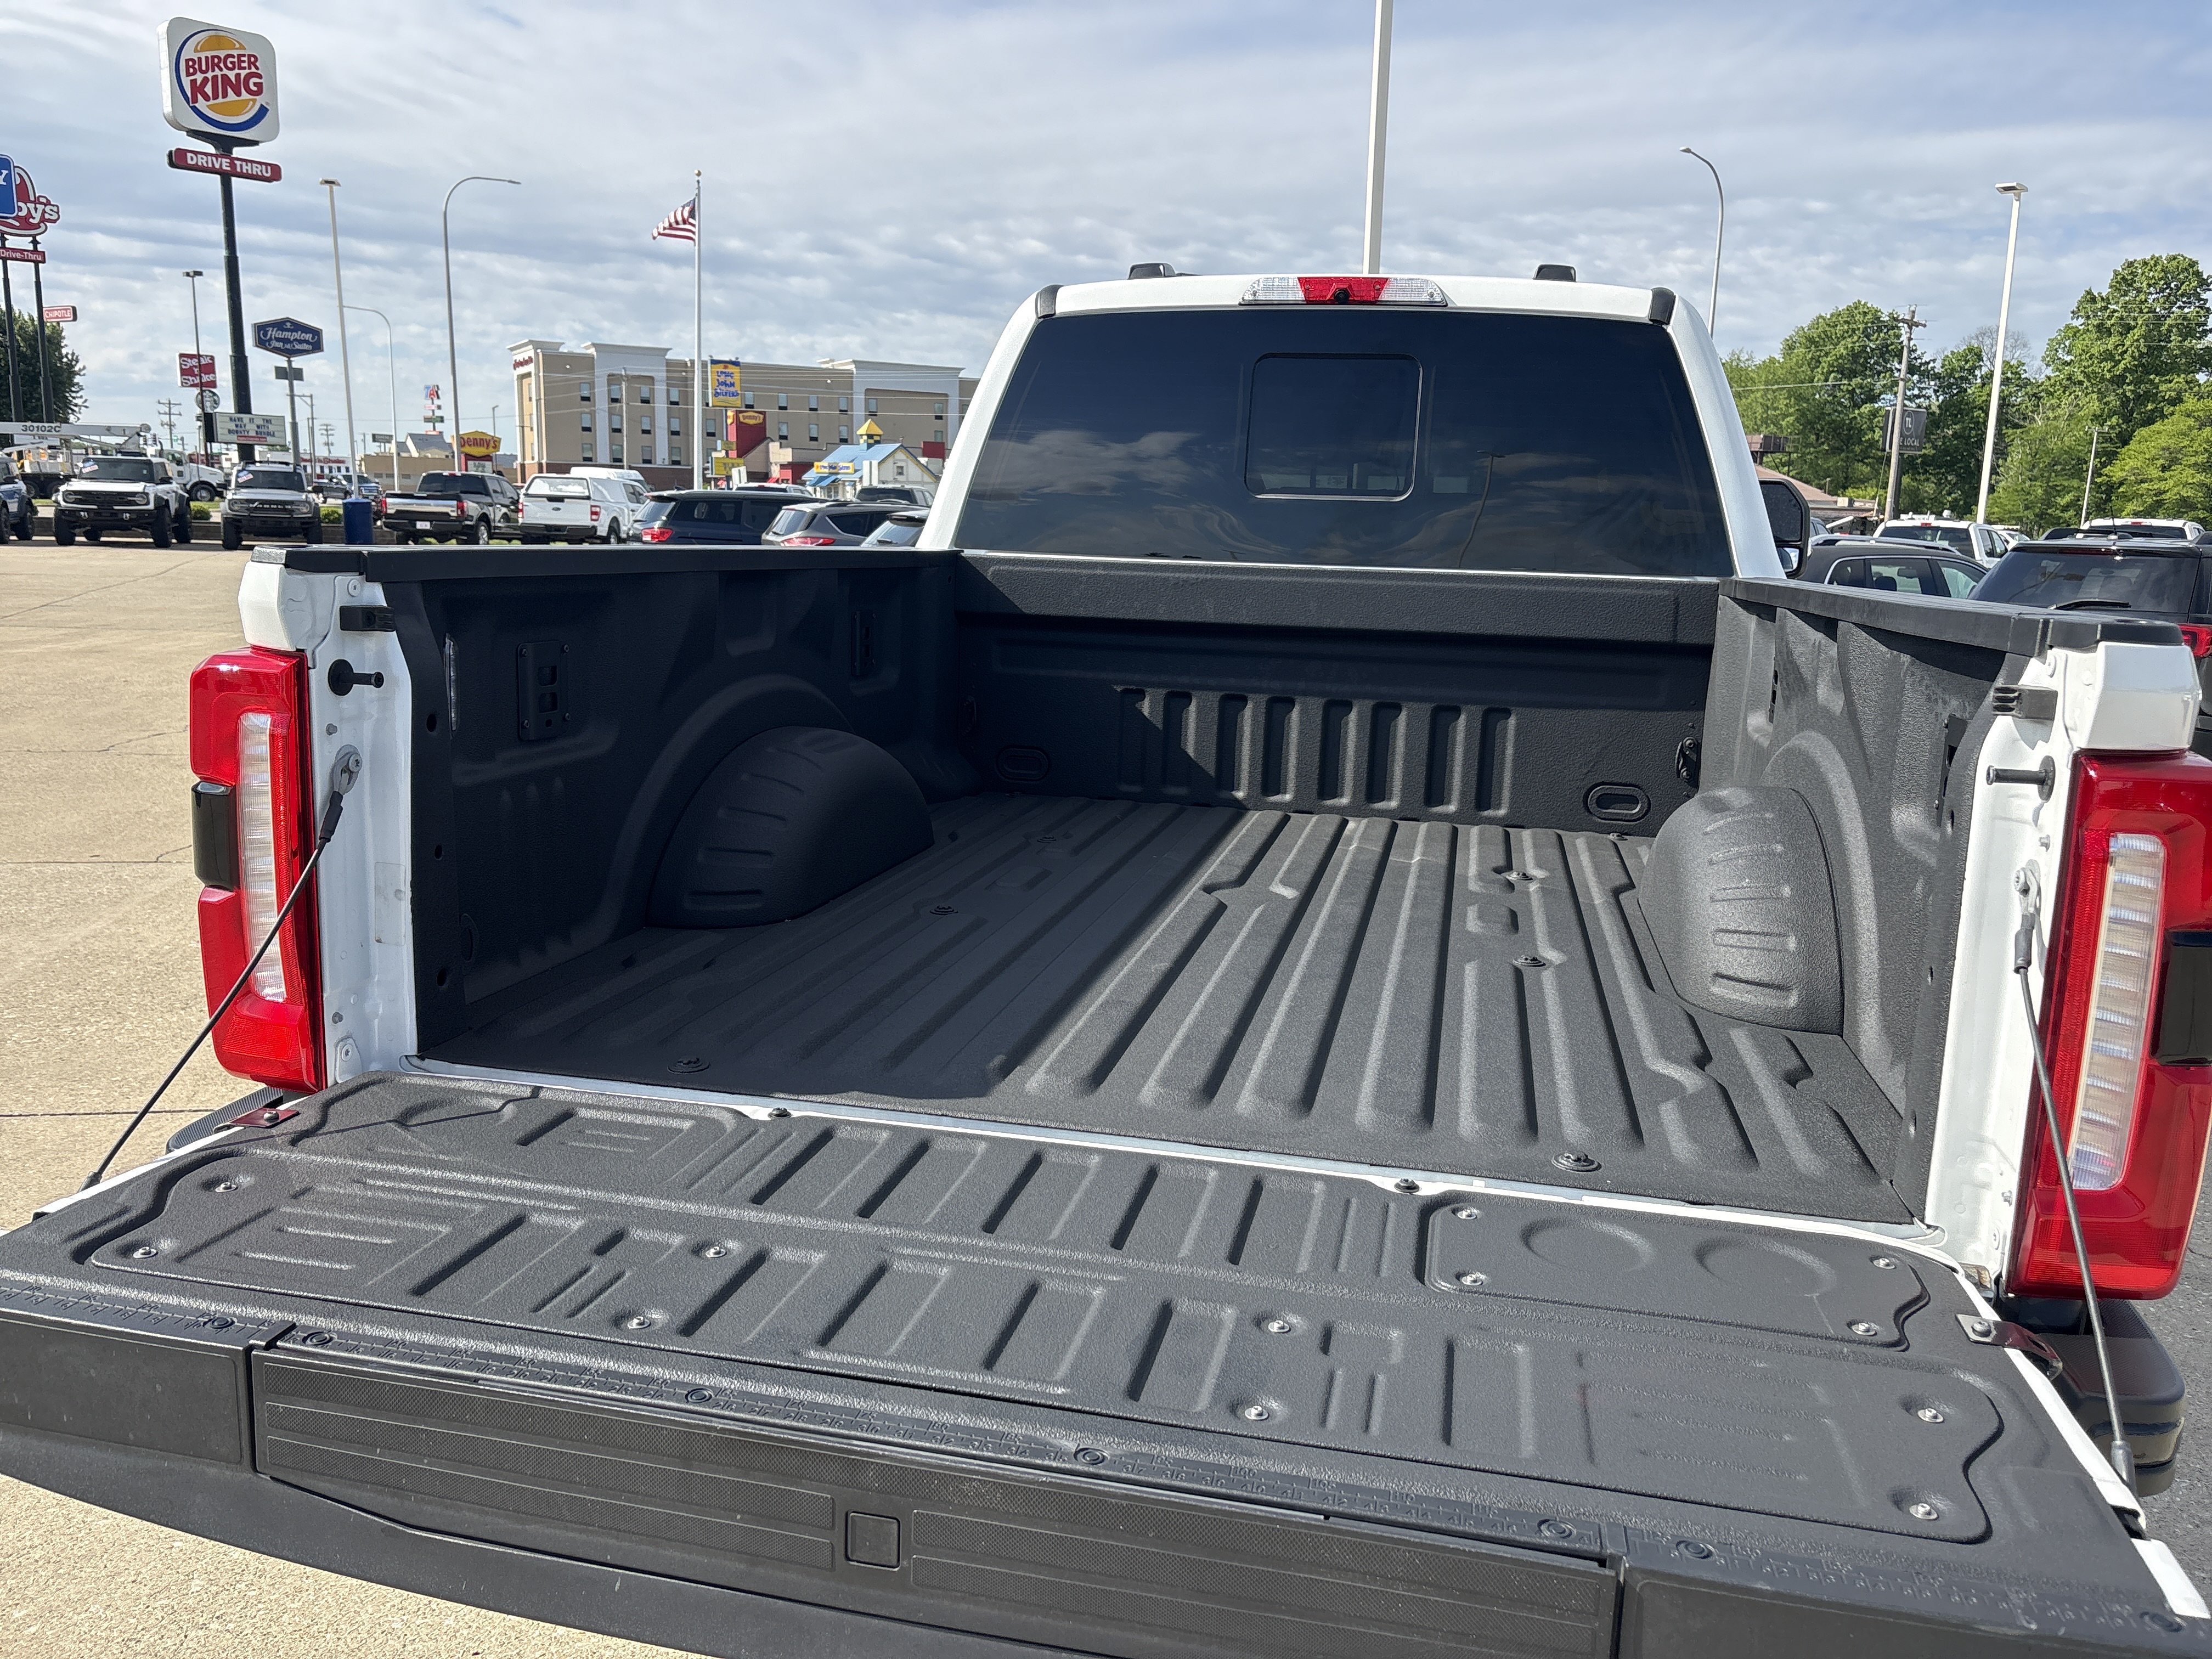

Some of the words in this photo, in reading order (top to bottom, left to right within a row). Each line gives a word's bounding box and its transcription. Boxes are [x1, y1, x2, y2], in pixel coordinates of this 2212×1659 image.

[185, 53, 259, 77] BURGER
[189, 71, 264, 105] KING
[186, 152, 231, 171] DRIVE
[234, 160, 272, 177] THRU
[0, 249, 42, 261] Drive-Thru
[44, 309, 71, 318] CHIPOTLE
[259, 327, 318, 343] Hampton
[266, 340, 285, 349] Inn
[291, 341, 313, 351] Suites
[180, 356, 213, 369] Steak
[181, 373, 216, 387] Shake
[716, 370, 735, 379] LONG
[424, 384, 441, 400] TAX
[21, 425, 61, 433] 30102C
[1905, 417, 1912, 428] TL
[460, 436, 498, 450] Denny's
[1904, 437, 1920, 447] LOCAL
